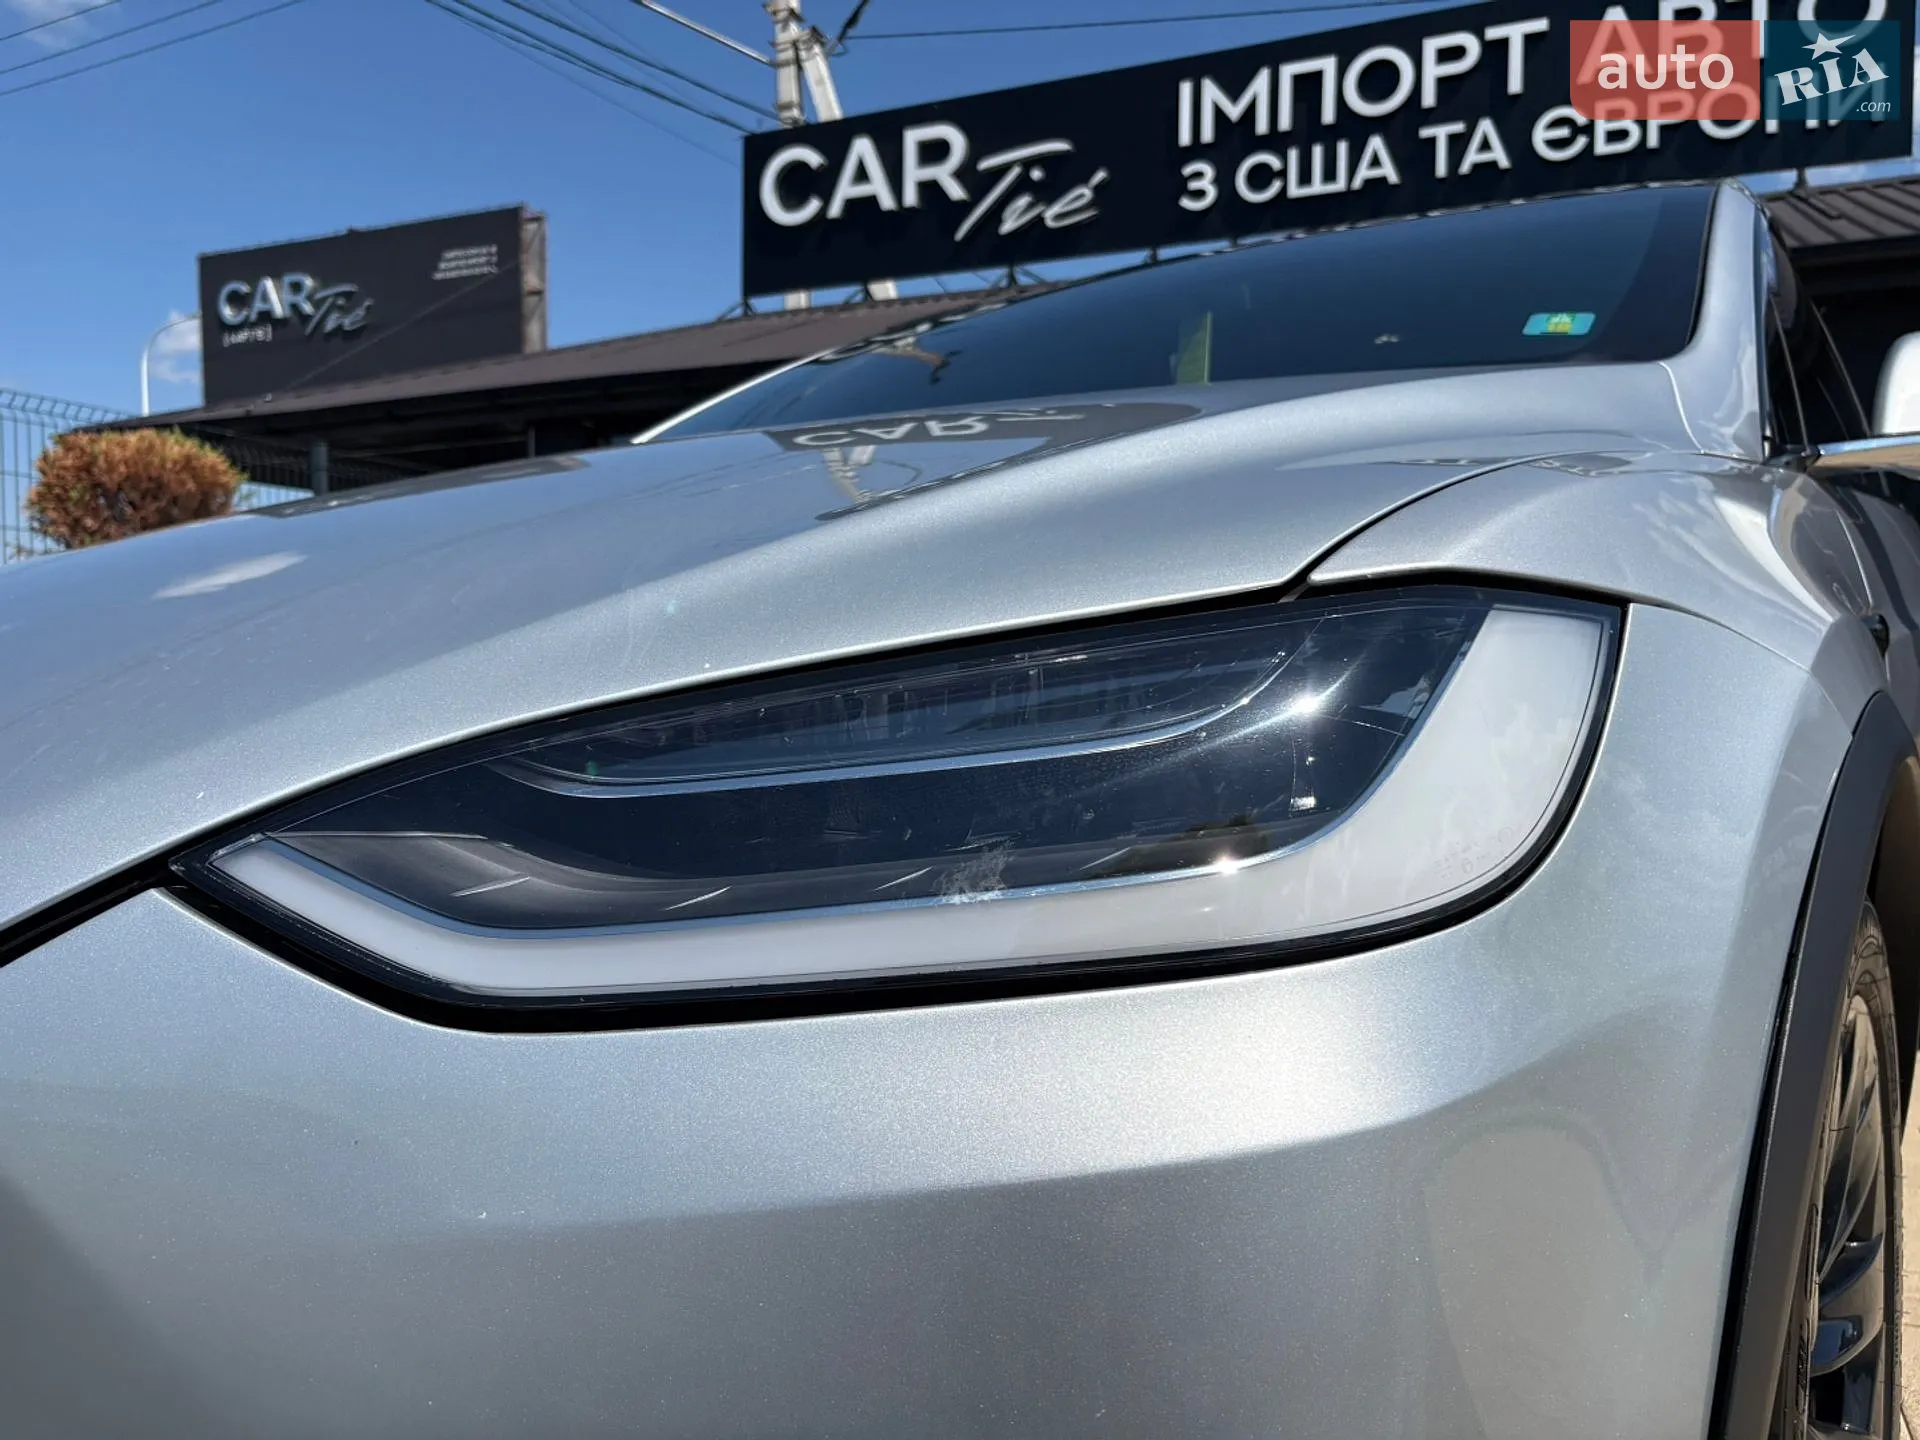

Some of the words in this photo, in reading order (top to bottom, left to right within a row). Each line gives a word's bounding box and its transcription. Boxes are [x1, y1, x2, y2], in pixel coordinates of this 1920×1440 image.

[1177, 18, 1551, 148] ІМПОРТ
[758, 121, 970, 227] CAR
[1234, 132, 1402, 204] США
[1418, 116, 1513, 180] ТА
[217, 271, 316, 327] CAR
